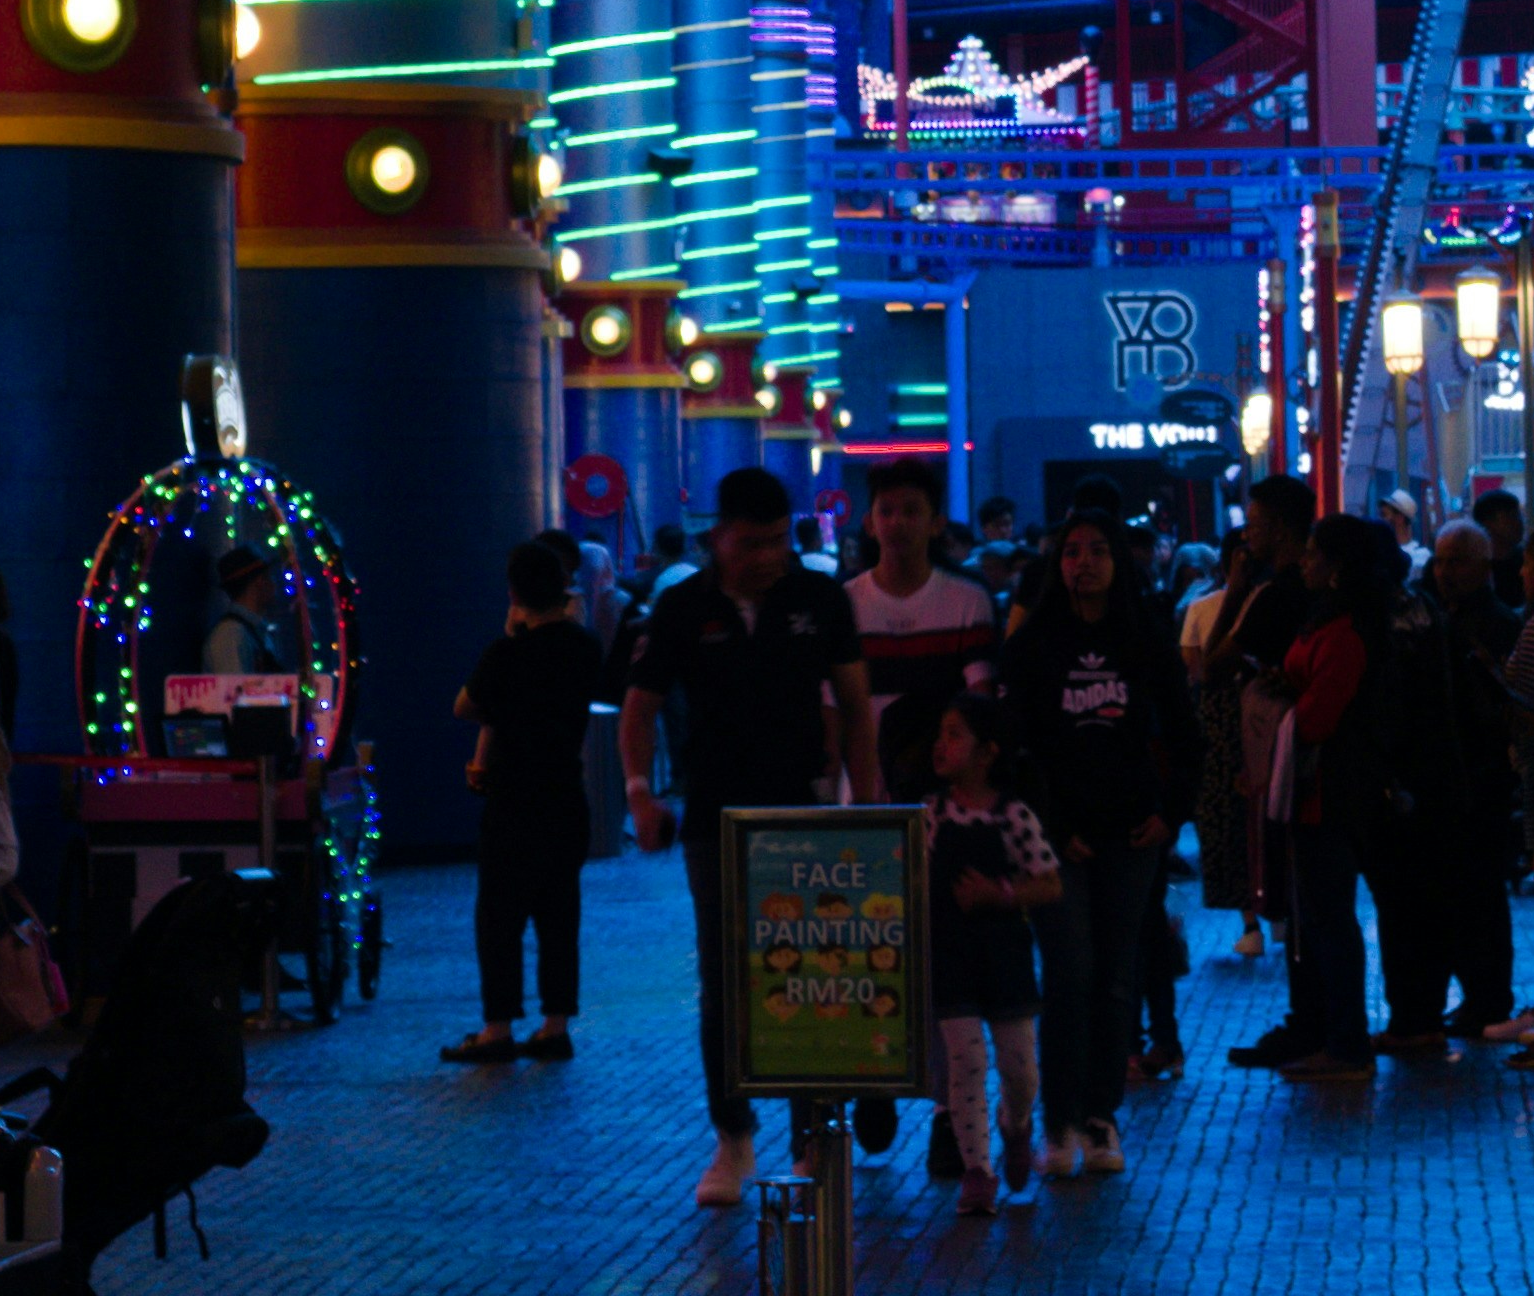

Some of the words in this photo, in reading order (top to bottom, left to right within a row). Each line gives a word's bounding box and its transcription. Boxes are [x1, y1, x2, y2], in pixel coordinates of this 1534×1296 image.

[1089, 422, 1144, 450] THE
[1061, 680, 1129, 714] ADIDAS
[792, 862, 866, 889] FACE
[754, 919, 904, 945] PAINTING
[786, 977, 875, 1003] RM20
